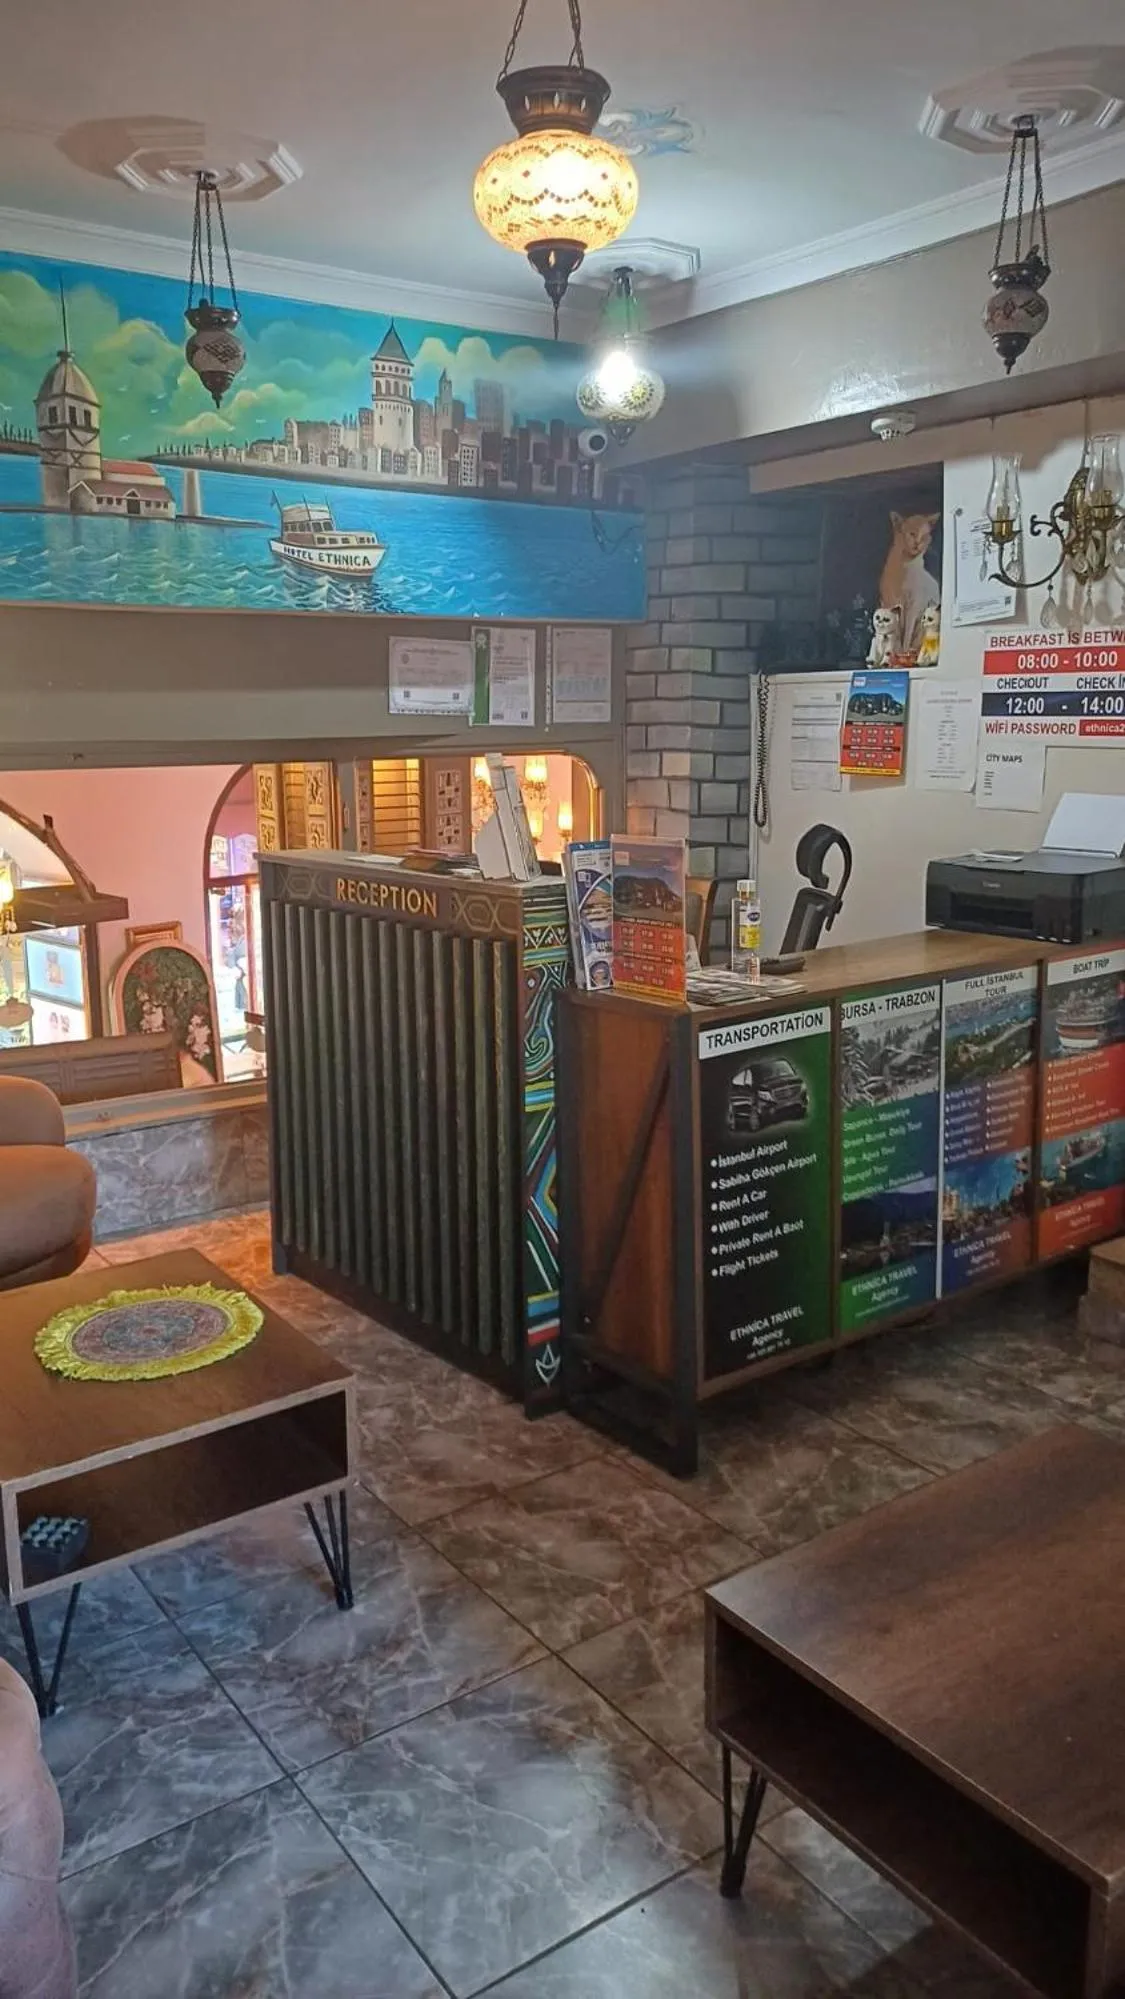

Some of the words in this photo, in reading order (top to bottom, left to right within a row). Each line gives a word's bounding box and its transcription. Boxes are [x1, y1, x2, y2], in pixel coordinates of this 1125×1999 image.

[318, 552, 371, 567] ETHNICA
[990, 633, 1064, 648] BREAKFAST
[1017, 653, 1059, 670] 08:00
[1074, 650, 1118, 668] 10:00
[1076, 676, 1116, 690] CHECK
[1006, 697, 1045, 714] 12:00
[1081, 696, 1124, 714] 14:00
[1011, 722, 1077, 735] PASSWORD
[336, 877, 437, 918] RECEPTION
[839, 1002, 876, 1020] BURSA
[885, 990, 936, 1012] TRABZON
[757, 1140, 788, 1157] Airport
[787, 1153, 817, 1169] Airport
[719, 1197, 741, 1212] Rent
[742, 1194, 750, 1204] A
[750, 1190, 767, 1202] Car
[719, 1218, 741, 1234] With
[741, 1210, 769, 1227] Driver
[719, 1238, 751, 1255] Private
[752, 1229, 774, 1244] Rent
[774, 1225, 782, 1236] A
[747, 1249, 779, 1267] Tickets
[770, 1304, 804, 1326] TRAVEL
